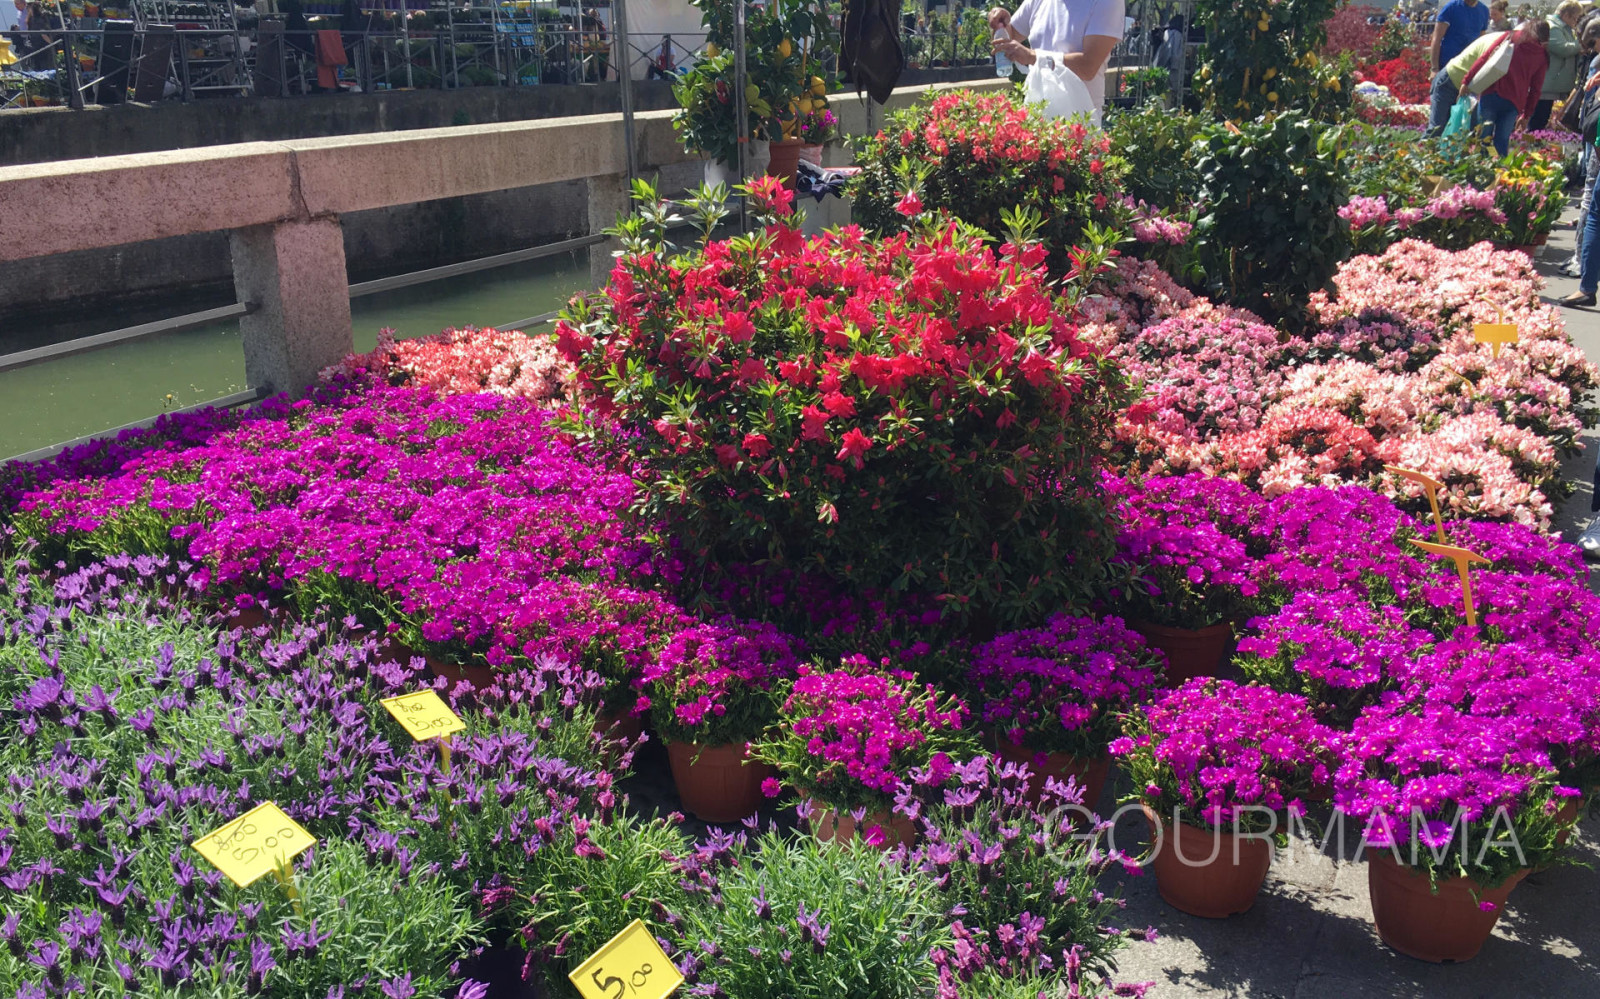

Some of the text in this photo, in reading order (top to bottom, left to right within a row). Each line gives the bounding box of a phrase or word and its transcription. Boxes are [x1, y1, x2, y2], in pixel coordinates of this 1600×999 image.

[407, 717, 453, 732] 5,00
[232, 827, 294, 864] 5,00
[591, 963, 653, 999] 5,00
